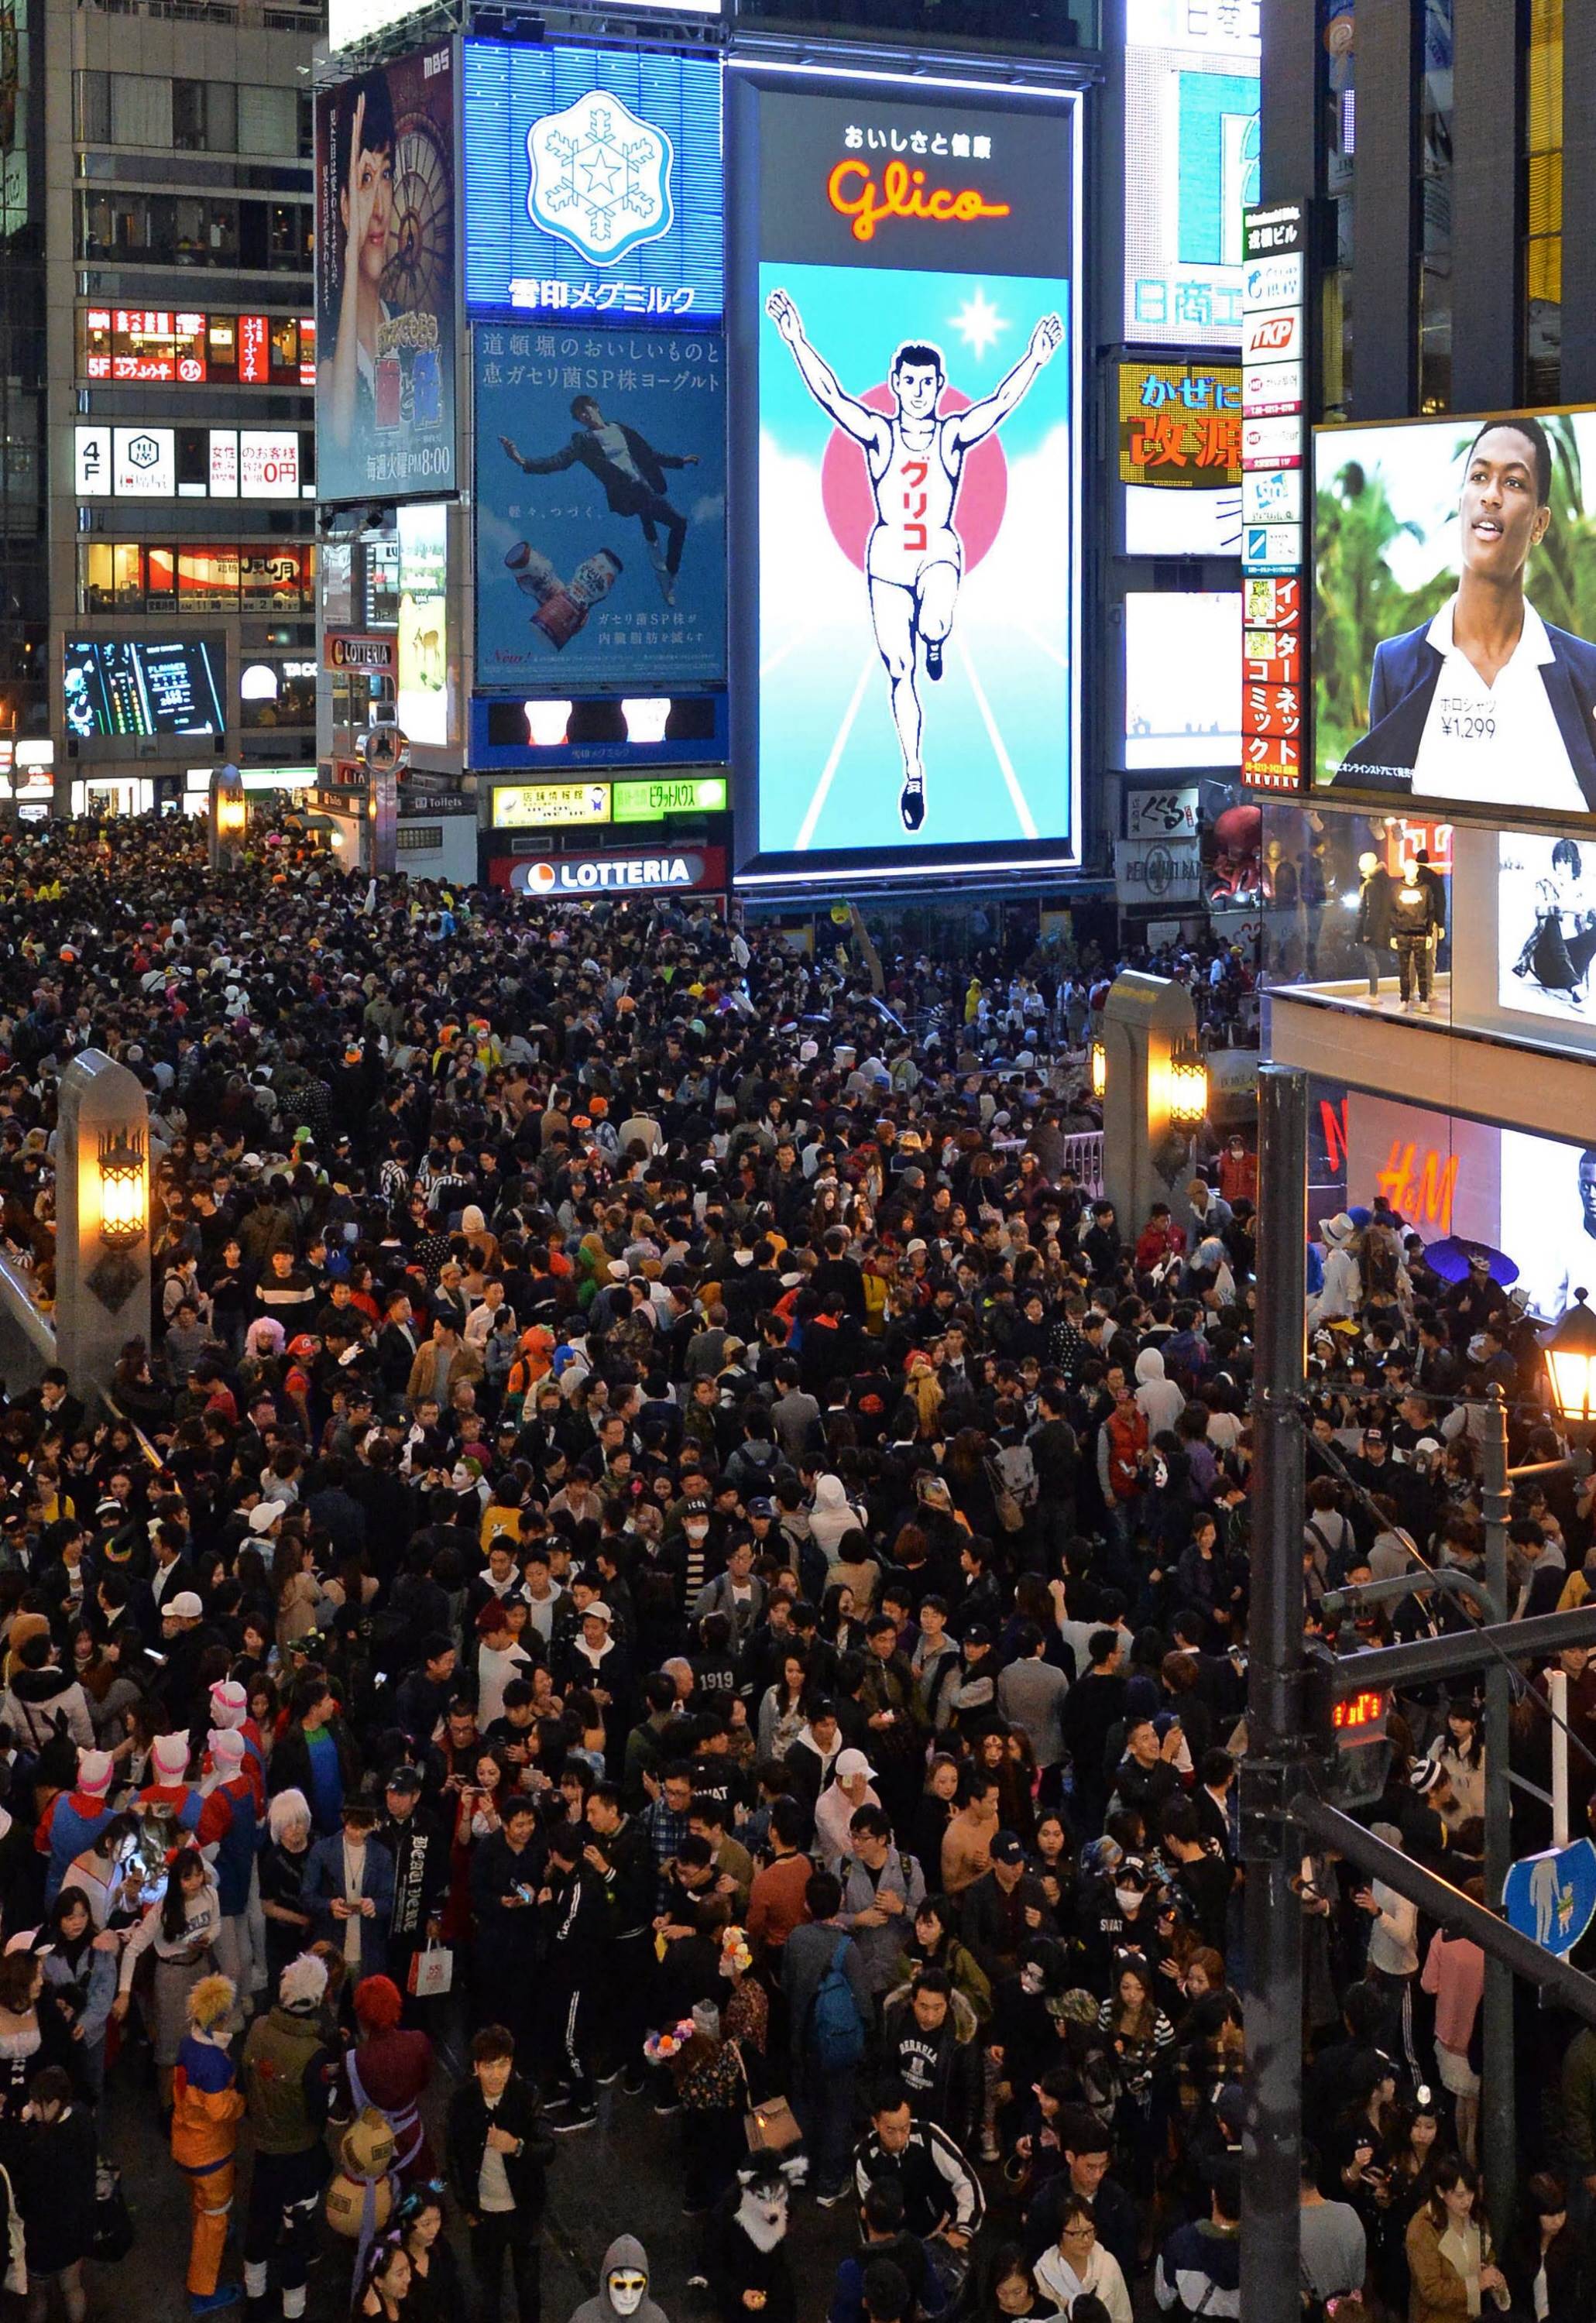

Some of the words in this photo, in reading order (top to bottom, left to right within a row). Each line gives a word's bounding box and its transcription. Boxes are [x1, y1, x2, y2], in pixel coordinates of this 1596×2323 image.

[424, 47, 449, 79] MBS
[828, 158, 1011, 242] Glico
[508, 278, 695, 314] 雪印メグミルク
[482, 332, 719, 362] 道頓堀のおいしいものと
[88, 358, 111, 376] 5F
[482, 362, 719, 392] 恵ガセリ菌SP株ヨーグルト
[898, 455, 933, 551] グリコ
[345, 642, 388, 664] LOTTERIA
[1275, 579, 1299, 766] インターネット
[1248, 661, 1272, 763] コミック
[430, 798, 462, 808] Toilets
[561, 858, 690, 888] LOTTERIA
[1375, 1140, 1460, 1234] H&M
[700, 1671, 733, 1690] 1919
[1100, 1919, 1123, 1932] SWAT
